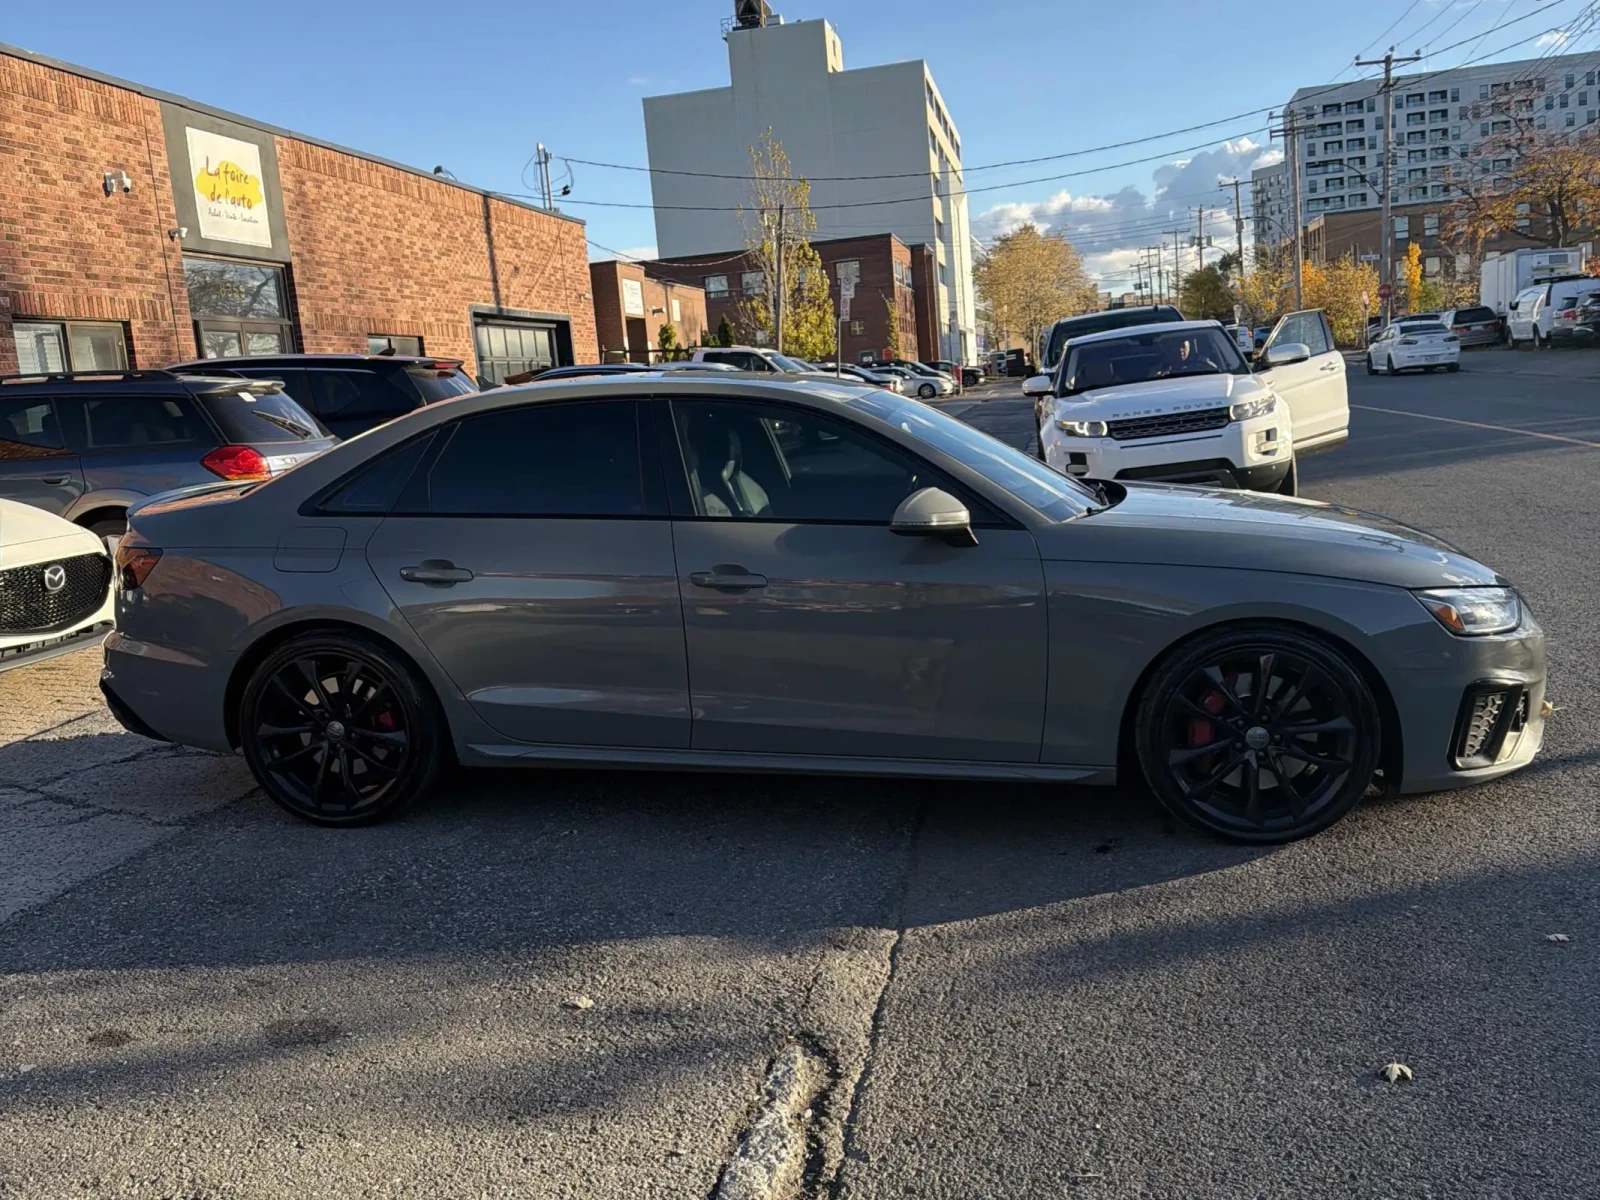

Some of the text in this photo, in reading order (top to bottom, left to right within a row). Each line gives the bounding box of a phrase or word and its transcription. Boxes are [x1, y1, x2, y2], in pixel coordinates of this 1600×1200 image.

[205, 155, 249, 184] La foire
[210, 183, 253, 209] de l'auto
[1112, 401, 1223, 418] RANGE ROVER
